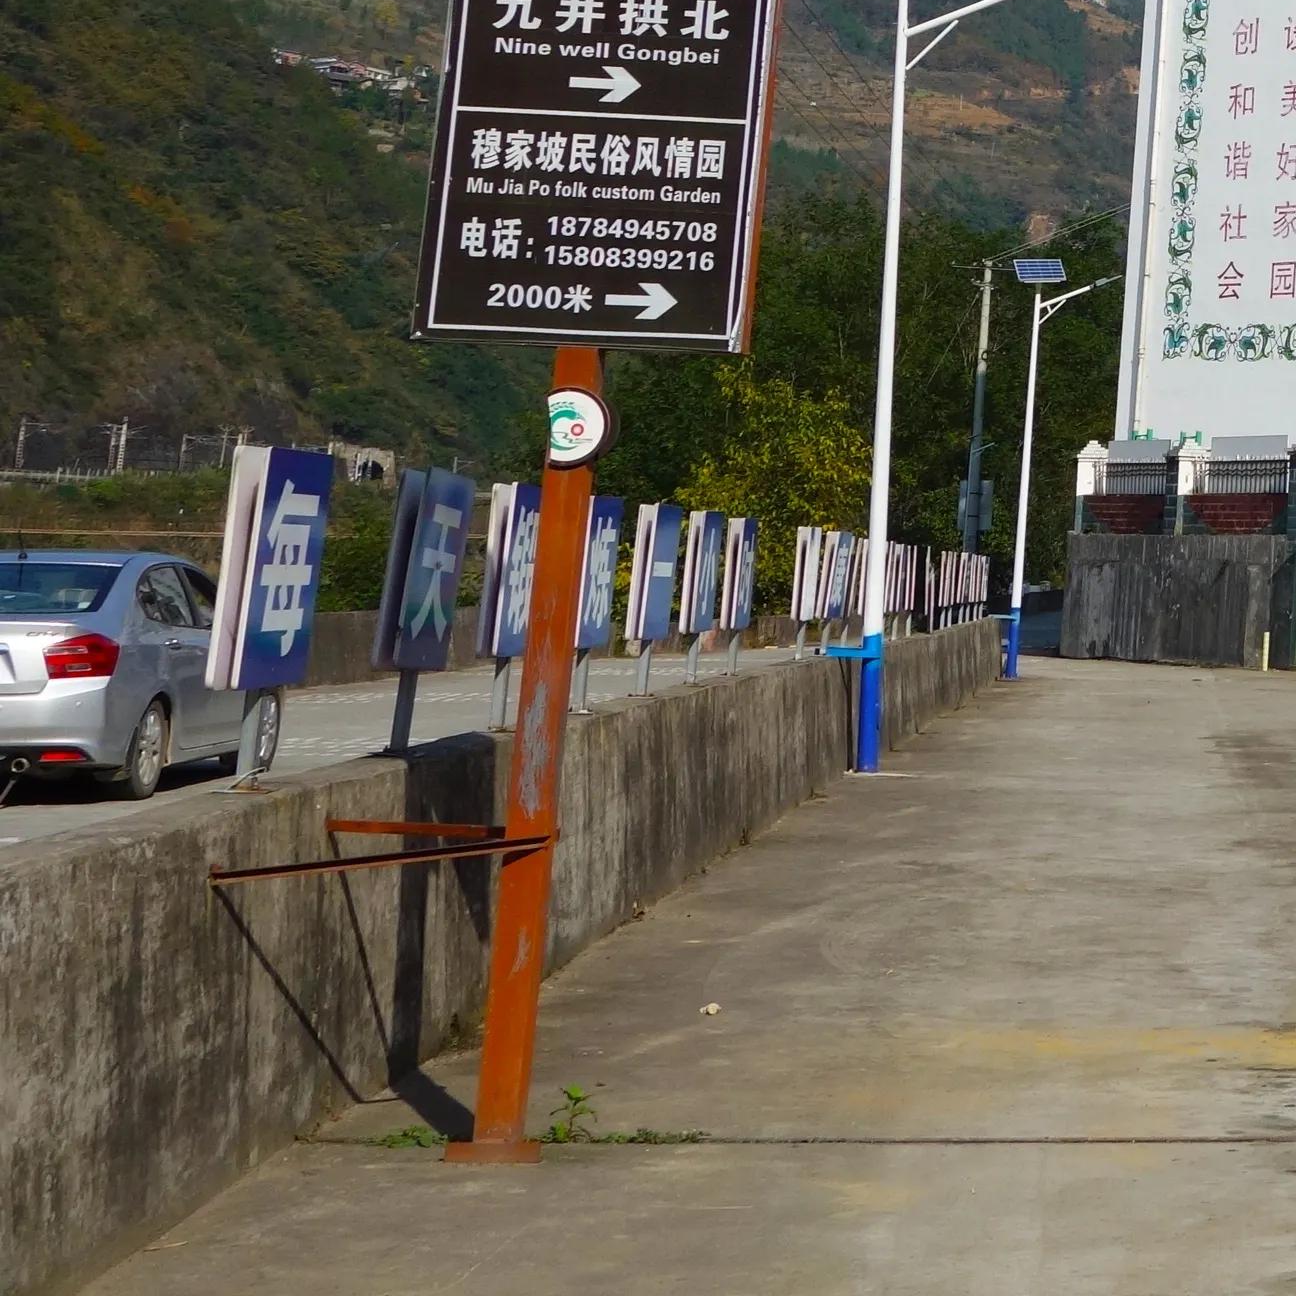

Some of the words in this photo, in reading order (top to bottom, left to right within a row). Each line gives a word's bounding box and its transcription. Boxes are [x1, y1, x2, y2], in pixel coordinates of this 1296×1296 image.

[495, 38, 551, 56] Nine
[559, 41, 609, 59] well
[618, 44, 720, 65] Gongbei
[471, 128, 726, 179] 穆家坡民俗风情园
[467, 177, 492, 195] Mu
[498, 178, 523, 197] Jia
[529, 179, 550, 197] Po
[555, 180, 586, 199] folk
[592, 186, 655, 202] custom
[660, 185, 721, 204] Garden
[547, 216, 717, 243] 18784945708
[544, 245, 714, 272] 15808399216
[487, 284, 593, 313] 2000米
[260, 478, 320, 657] 每
[411, 503, 462, 643] 天
